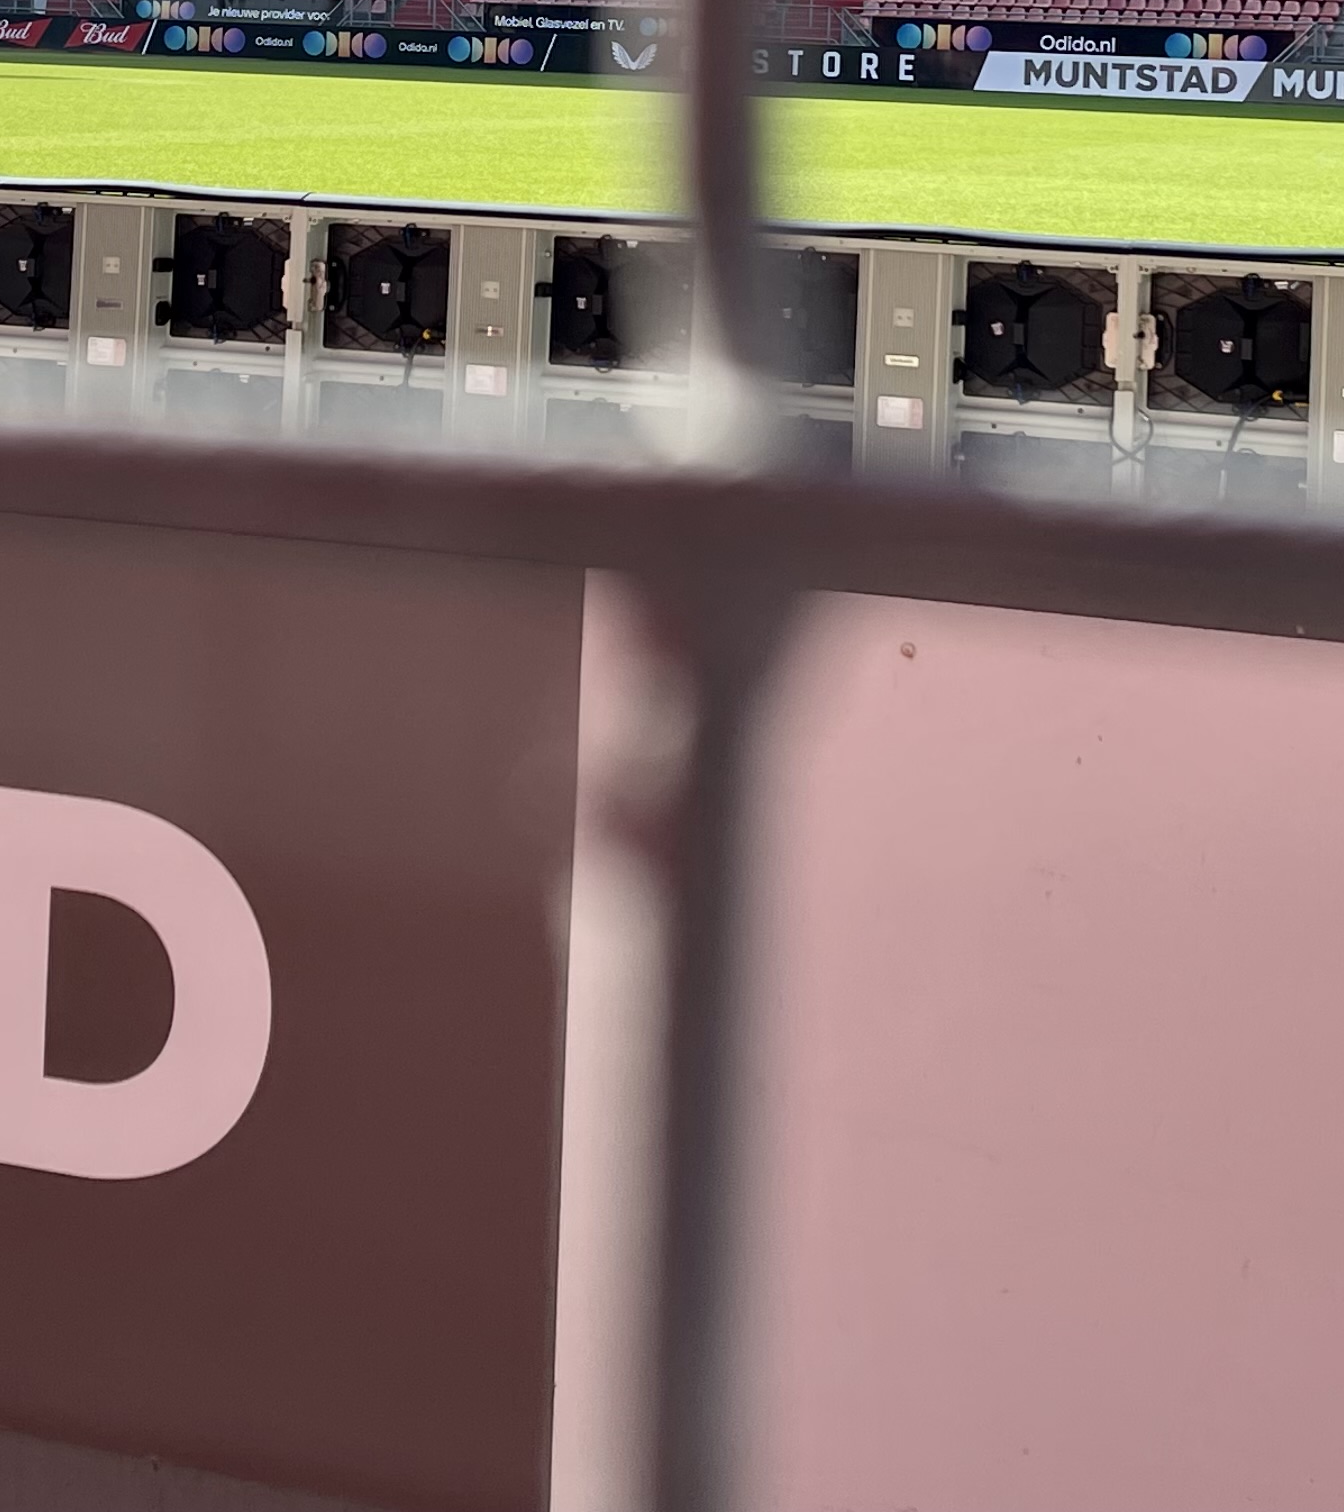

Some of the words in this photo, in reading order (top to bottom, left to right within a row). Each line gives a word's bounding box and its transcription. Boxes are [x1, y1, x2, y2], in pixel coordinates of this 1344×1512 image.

[221, 6, 259, 19] nieuwe
[260, 7, 305, 22] provider
[306, 11, 330, 22] voo
[80, 22, 130, 44] Bud
[590, 21, 605, 31] en
[1039, 34, 1116, 54] Odido.nl
[1023, 59, 1238, 94] MUNTSTAD
